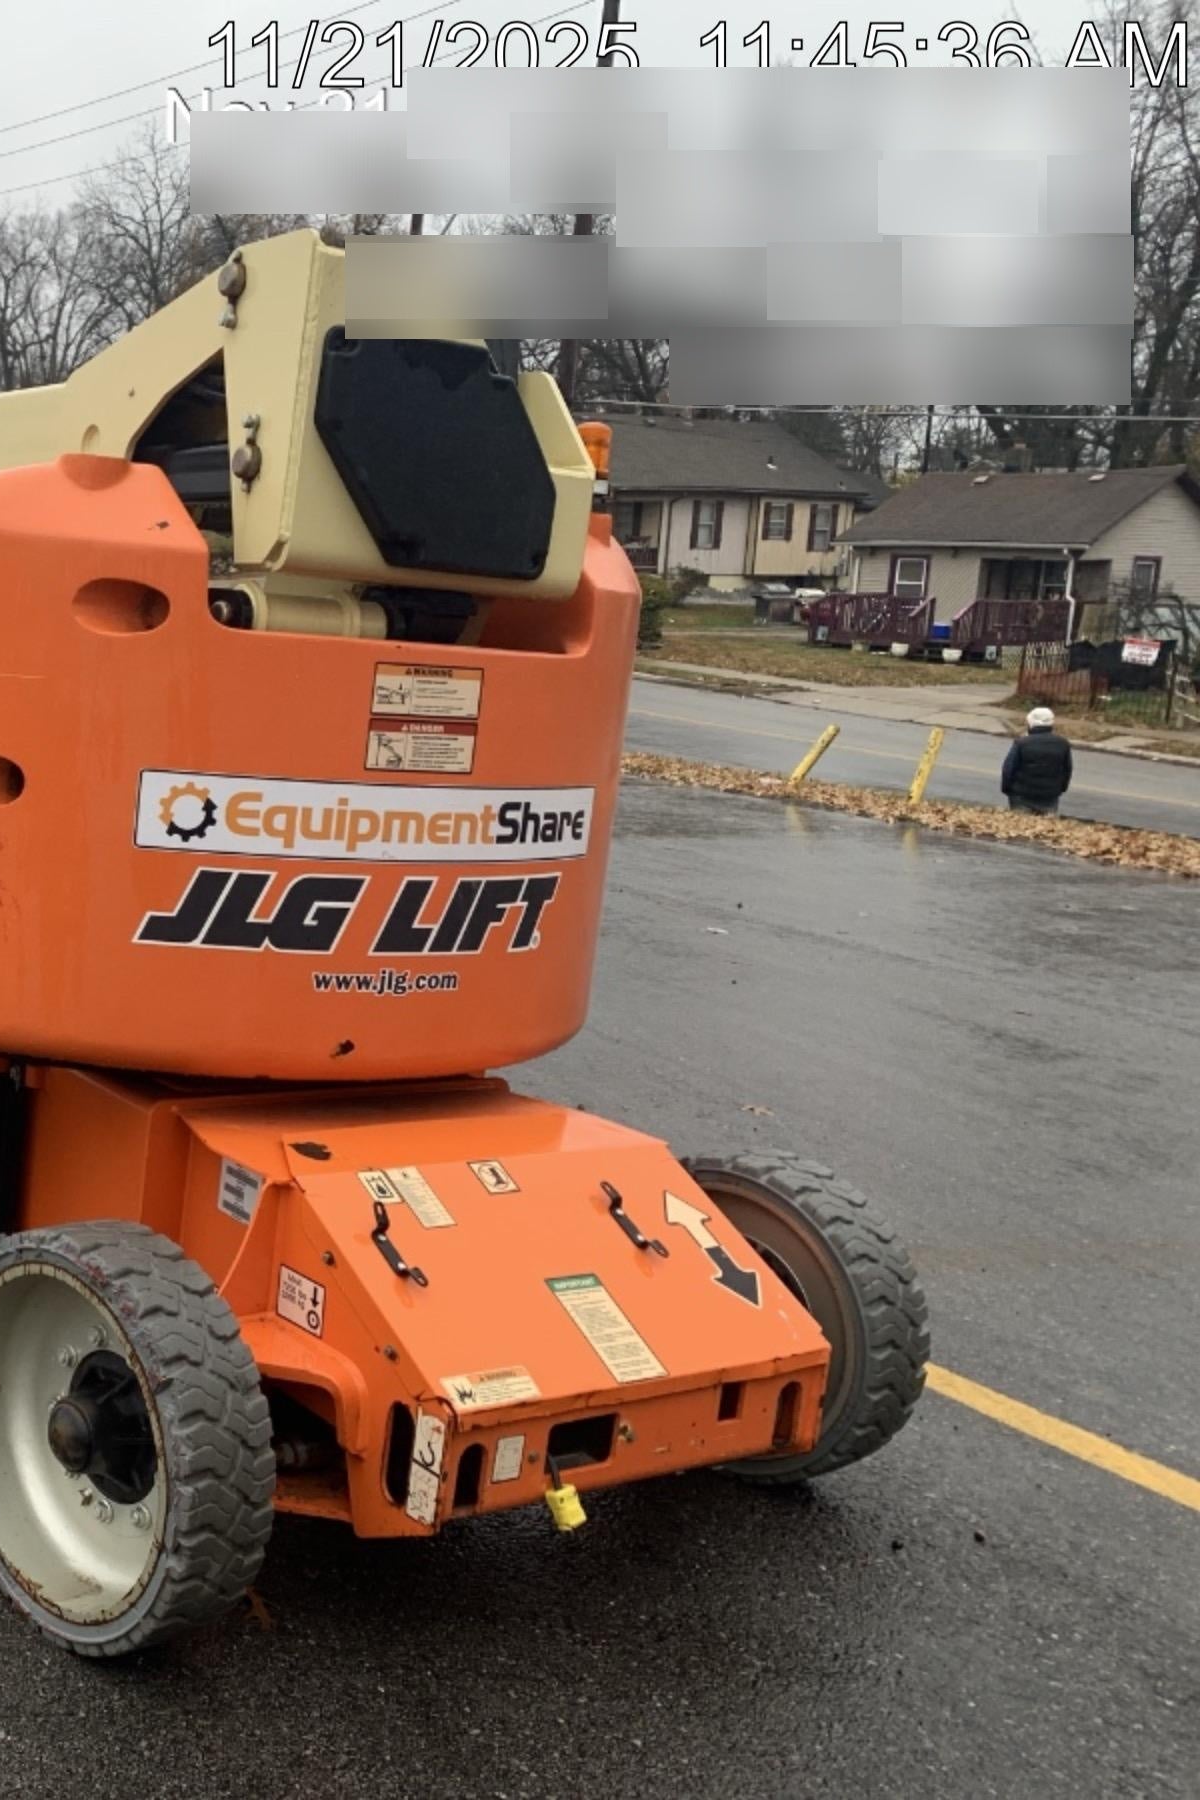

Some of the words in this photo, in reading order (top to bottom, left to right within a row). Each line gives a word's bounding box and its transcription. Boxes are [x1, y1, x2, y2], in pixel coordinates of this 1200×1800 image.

[224, 790, 585, 853] EquipmentShare
[132, 868, 371, 955] JLG
[368, 872, 562, 956] LIFT
[313, 968, 459, 996] www.jlg.com
